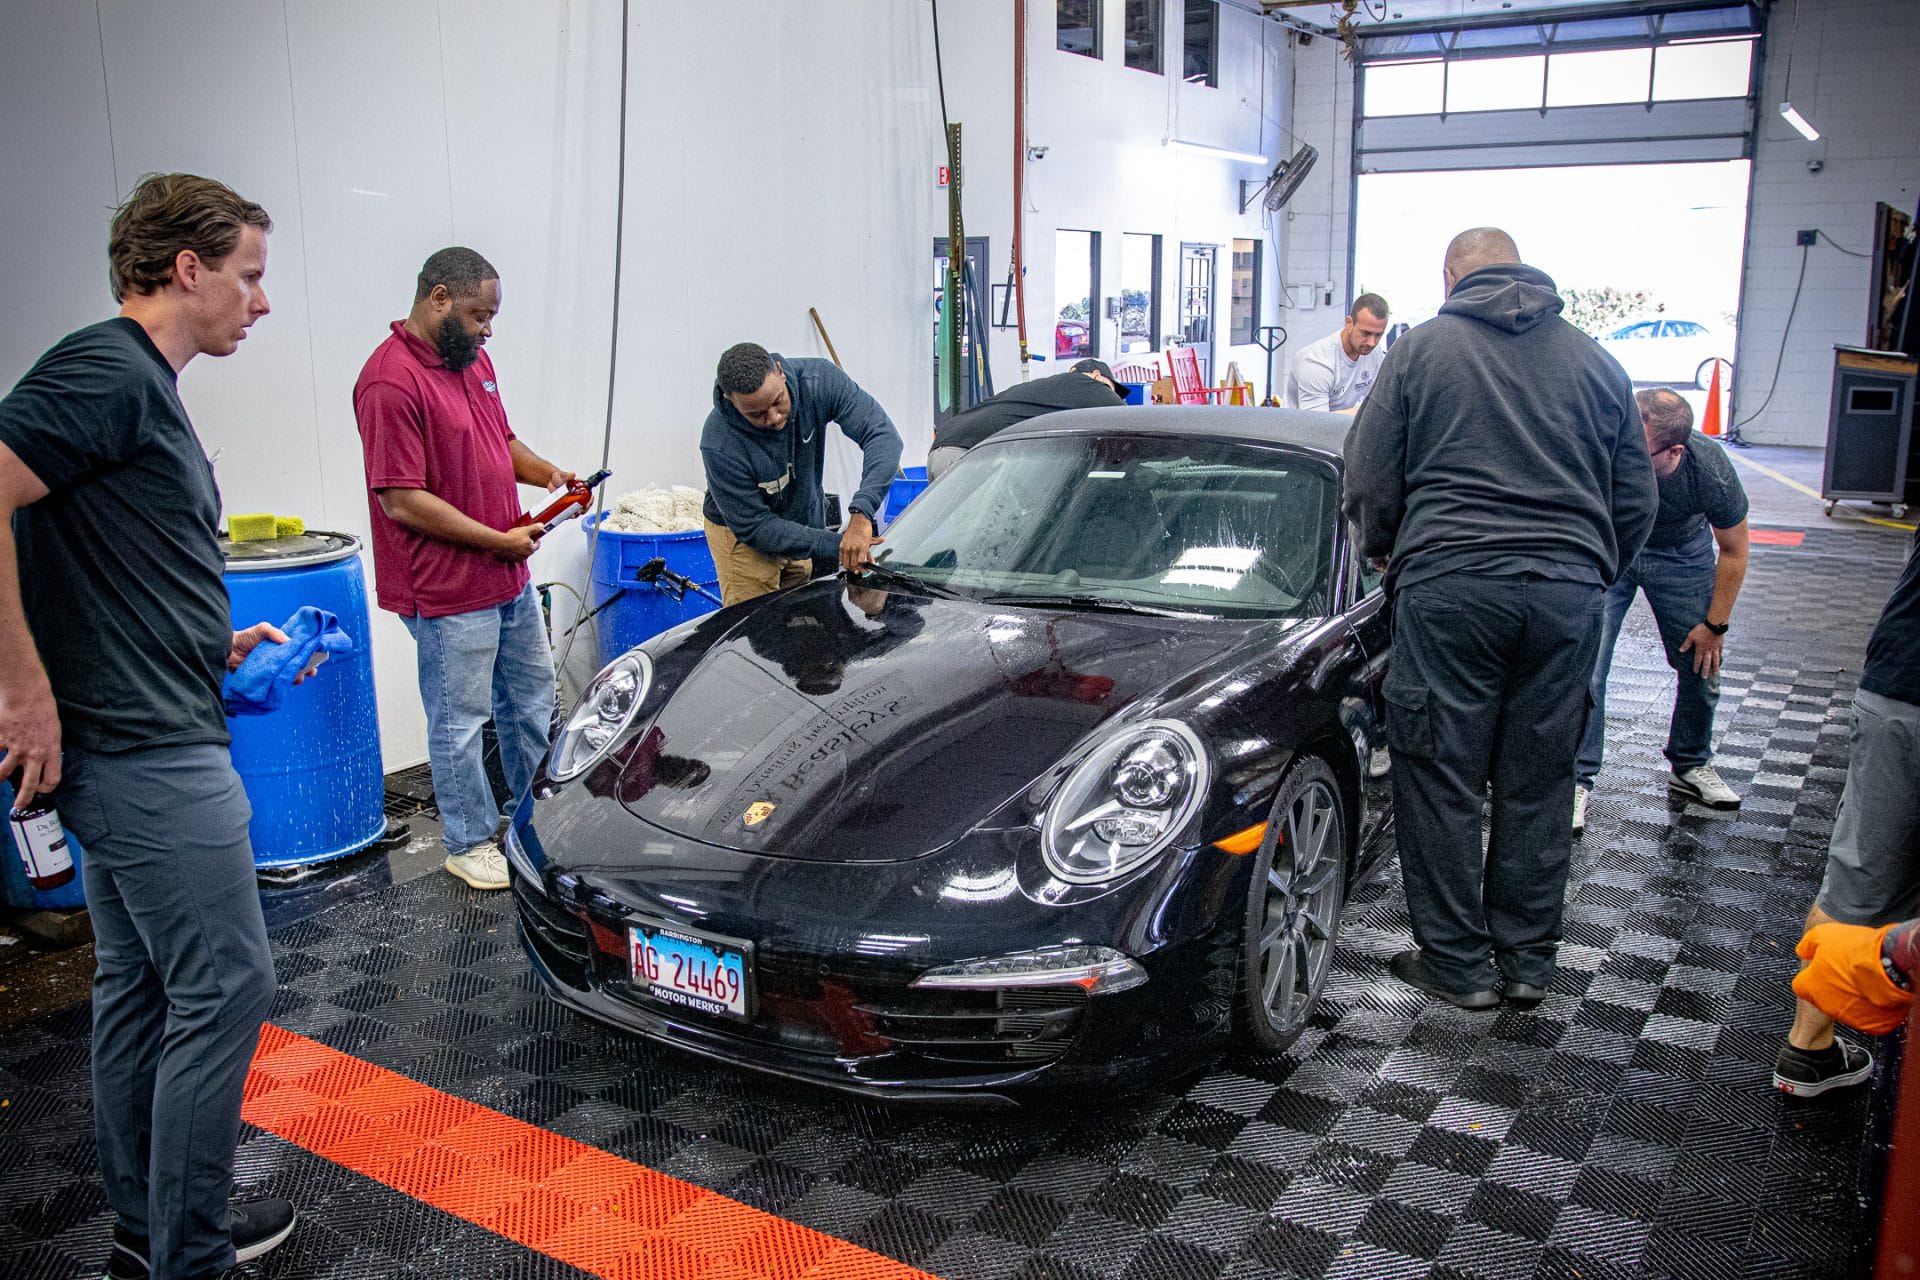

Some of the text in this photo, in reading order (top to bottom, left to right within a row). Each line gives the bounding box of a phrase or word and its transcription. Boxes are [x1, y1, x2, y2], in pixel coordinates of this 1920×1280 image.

[660, 929, 703, 945] BARRINGTON
[635, 943, 659, 981] AG
[672, 953, 739, 1003] 24469
[654, 987, 687, 1005] MOTOR
